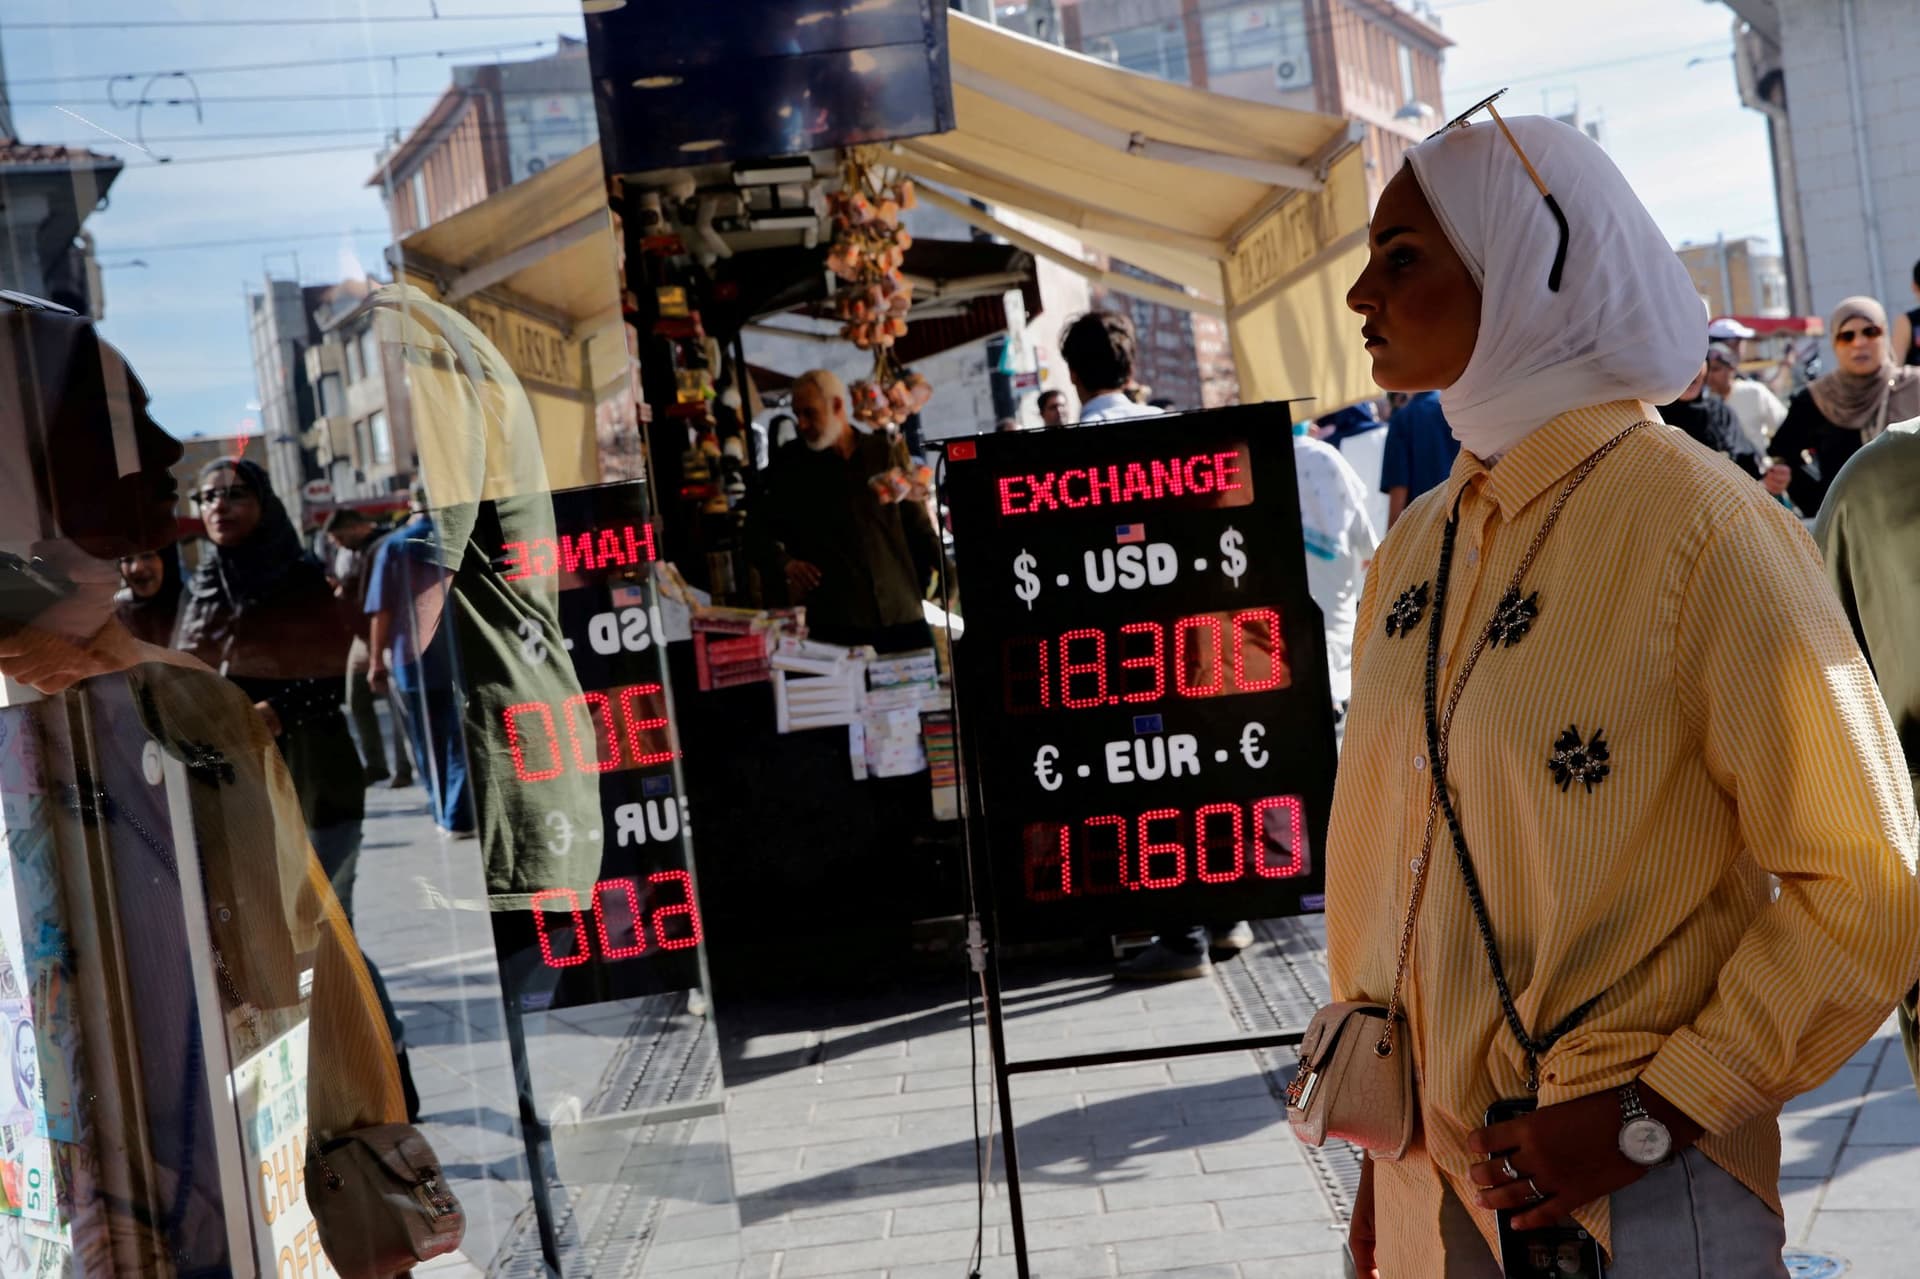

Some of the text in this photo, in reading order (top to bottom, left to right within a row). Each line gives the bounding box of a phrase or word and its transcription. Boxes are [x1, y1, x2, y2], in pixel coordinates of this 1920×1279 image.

[999, 450, 1243, 516] EXCHANGE
[1014, 525, 1248, 611] $ USD $
[1038, 608, 1282, 710] 18.300
[1034, 722, 1270, 791] € EUR €
[1060, 796, 1302, 895] 17.600
[26, 1168, 42, 1211] 50
[258, 1127, 307, 1226] CHA
[278, 1219, 332, 1279] OFF
